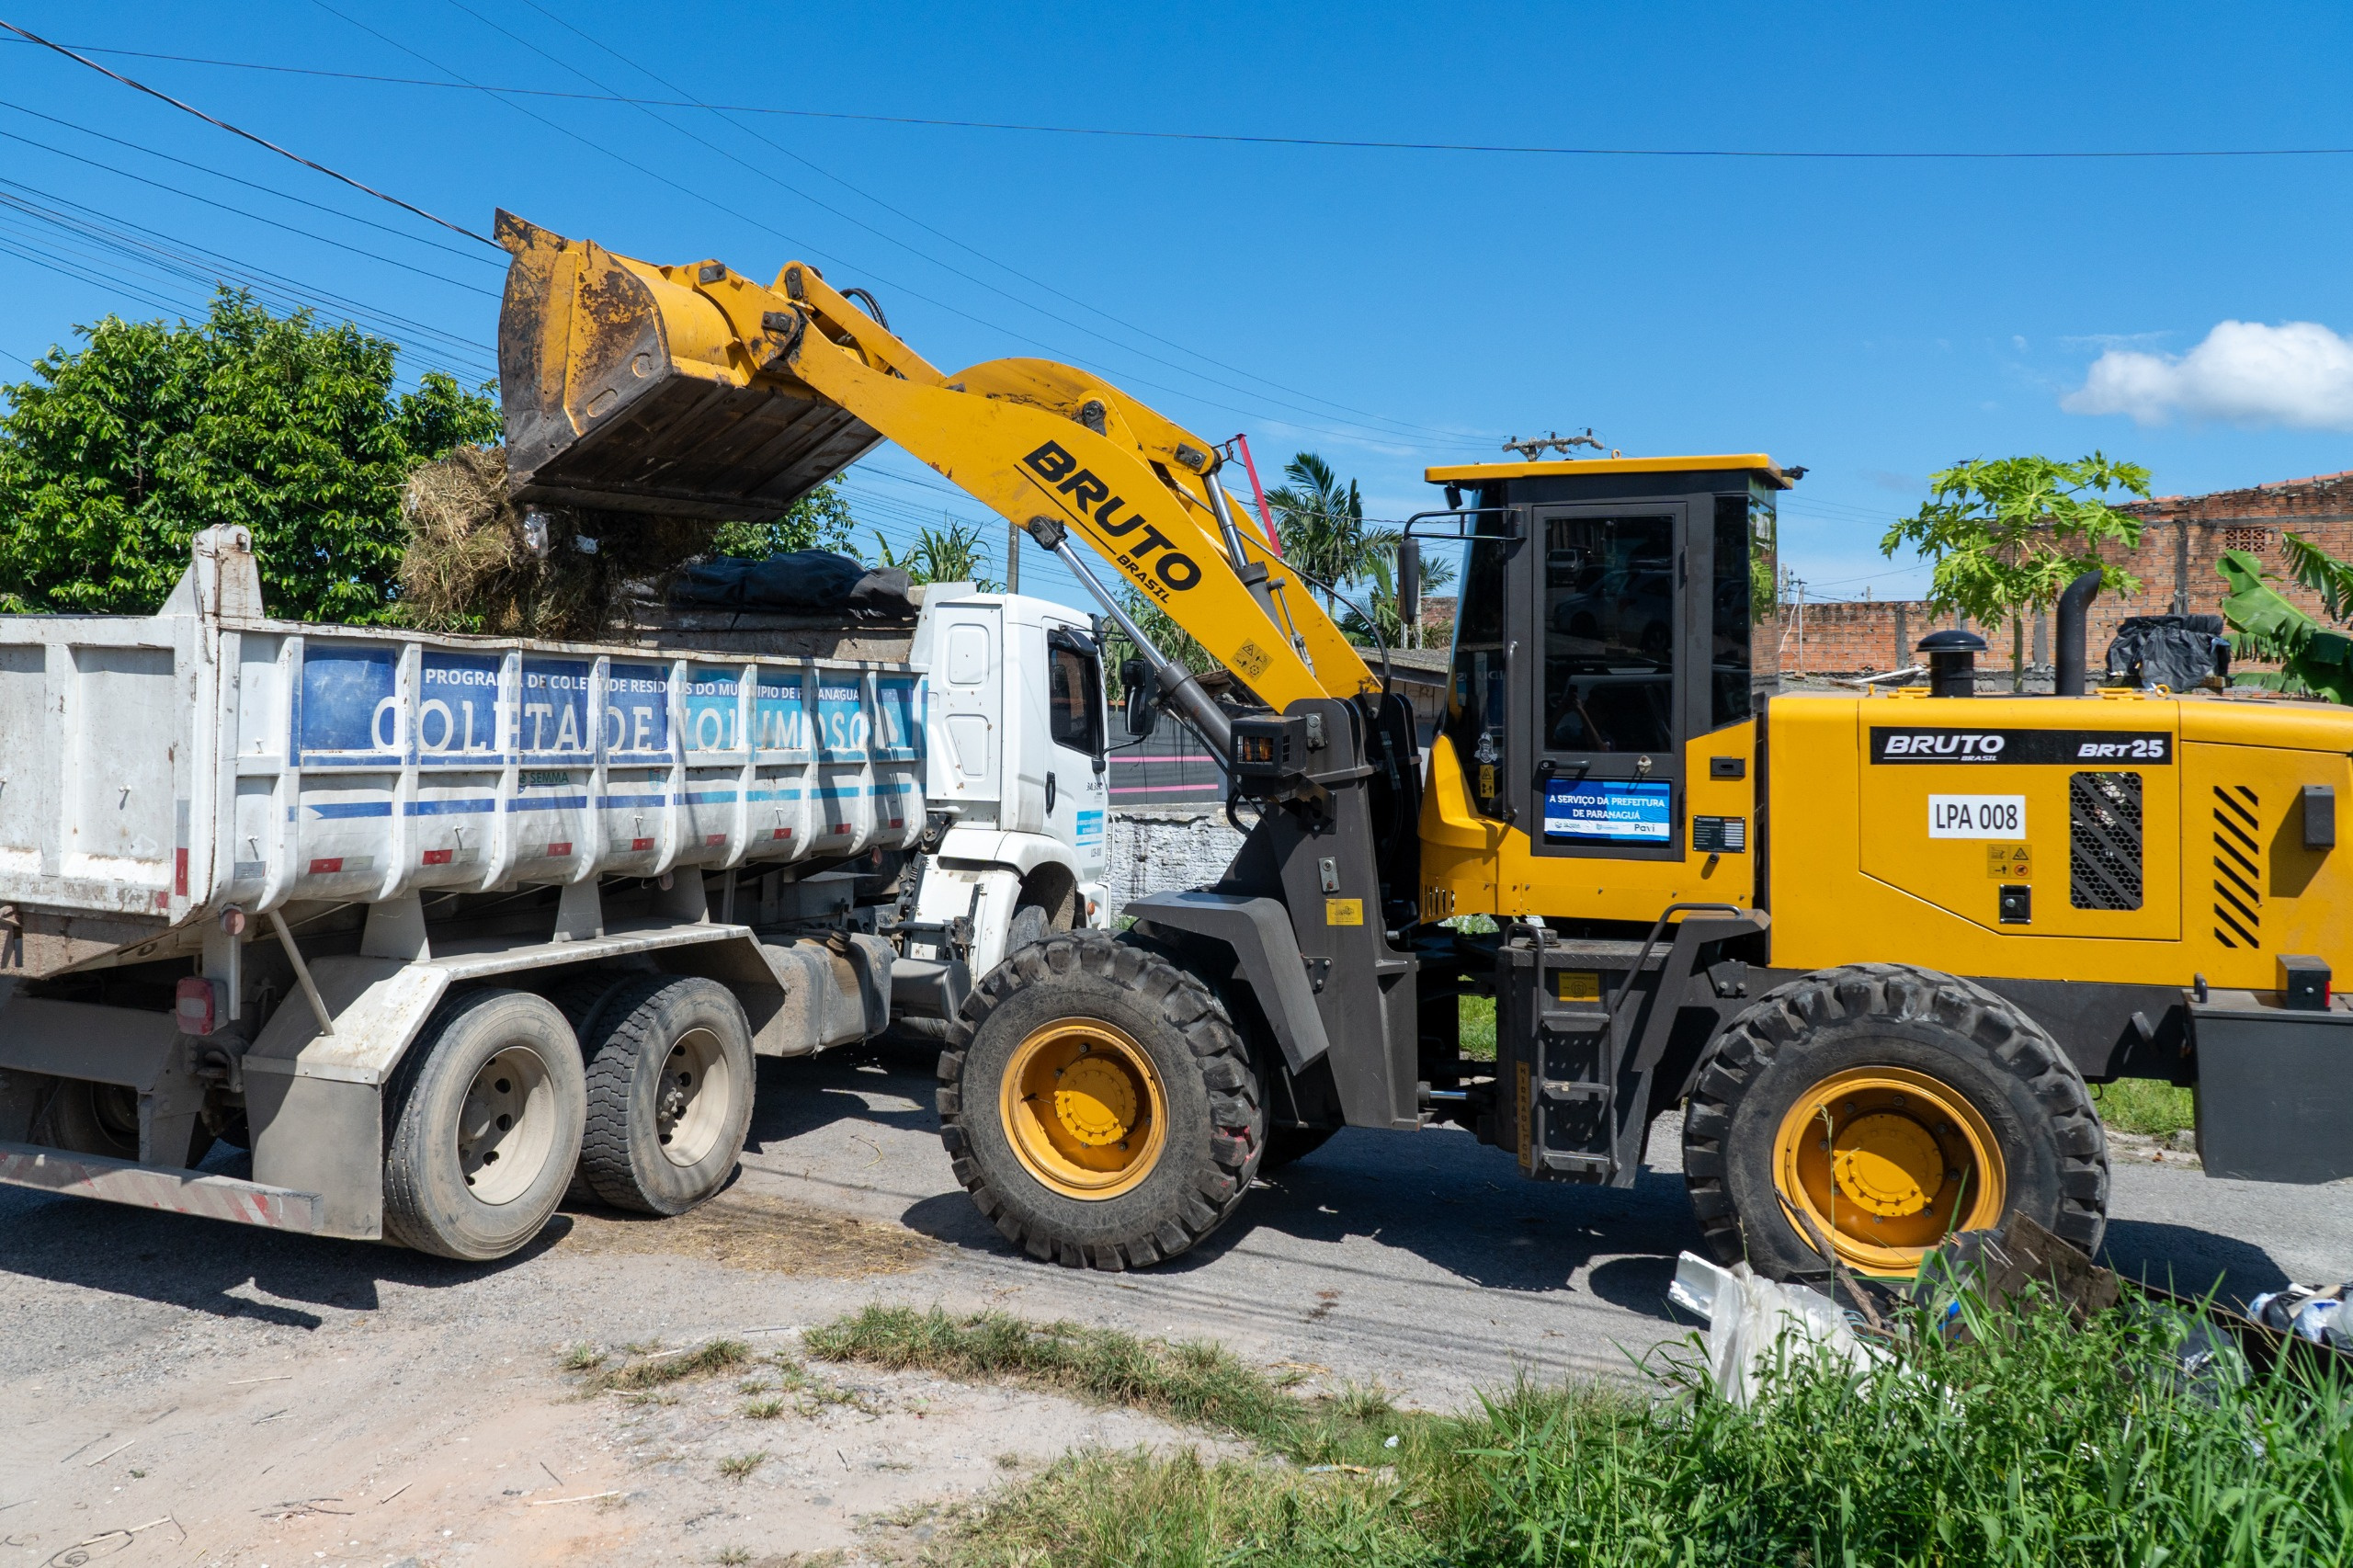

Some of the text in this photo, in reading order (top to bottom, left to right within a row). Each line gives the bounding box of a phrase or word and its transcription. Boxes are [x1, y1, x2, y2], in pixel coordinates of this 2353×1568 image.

[1022, 439, 1202, 591] BRUTO
[1116, 553, 1173, 605] BRASIL
[426, 668, 523, 687] PROGRA
[528, 674, 547, 688] DE
[550, 676, 609, 690] COLE
[609, 678, 627, 692] DE
[696, 683, 716, 696] DO
[719, 683, 779, 699] MUÍPIO
[781, 687, 795, 699] DE
[1884, 735, 2006, 754] BRUTO
[529, 772, 570, 783] SEMMA
[1557, 795, 1596, 806] SERVIÇO
[1610, 798, 1665, 807] PREFEITURA
[1572, 809, 1642, 820] DE PARANAGUÁ
[1935, 804, 2018, 830] LPA 008
